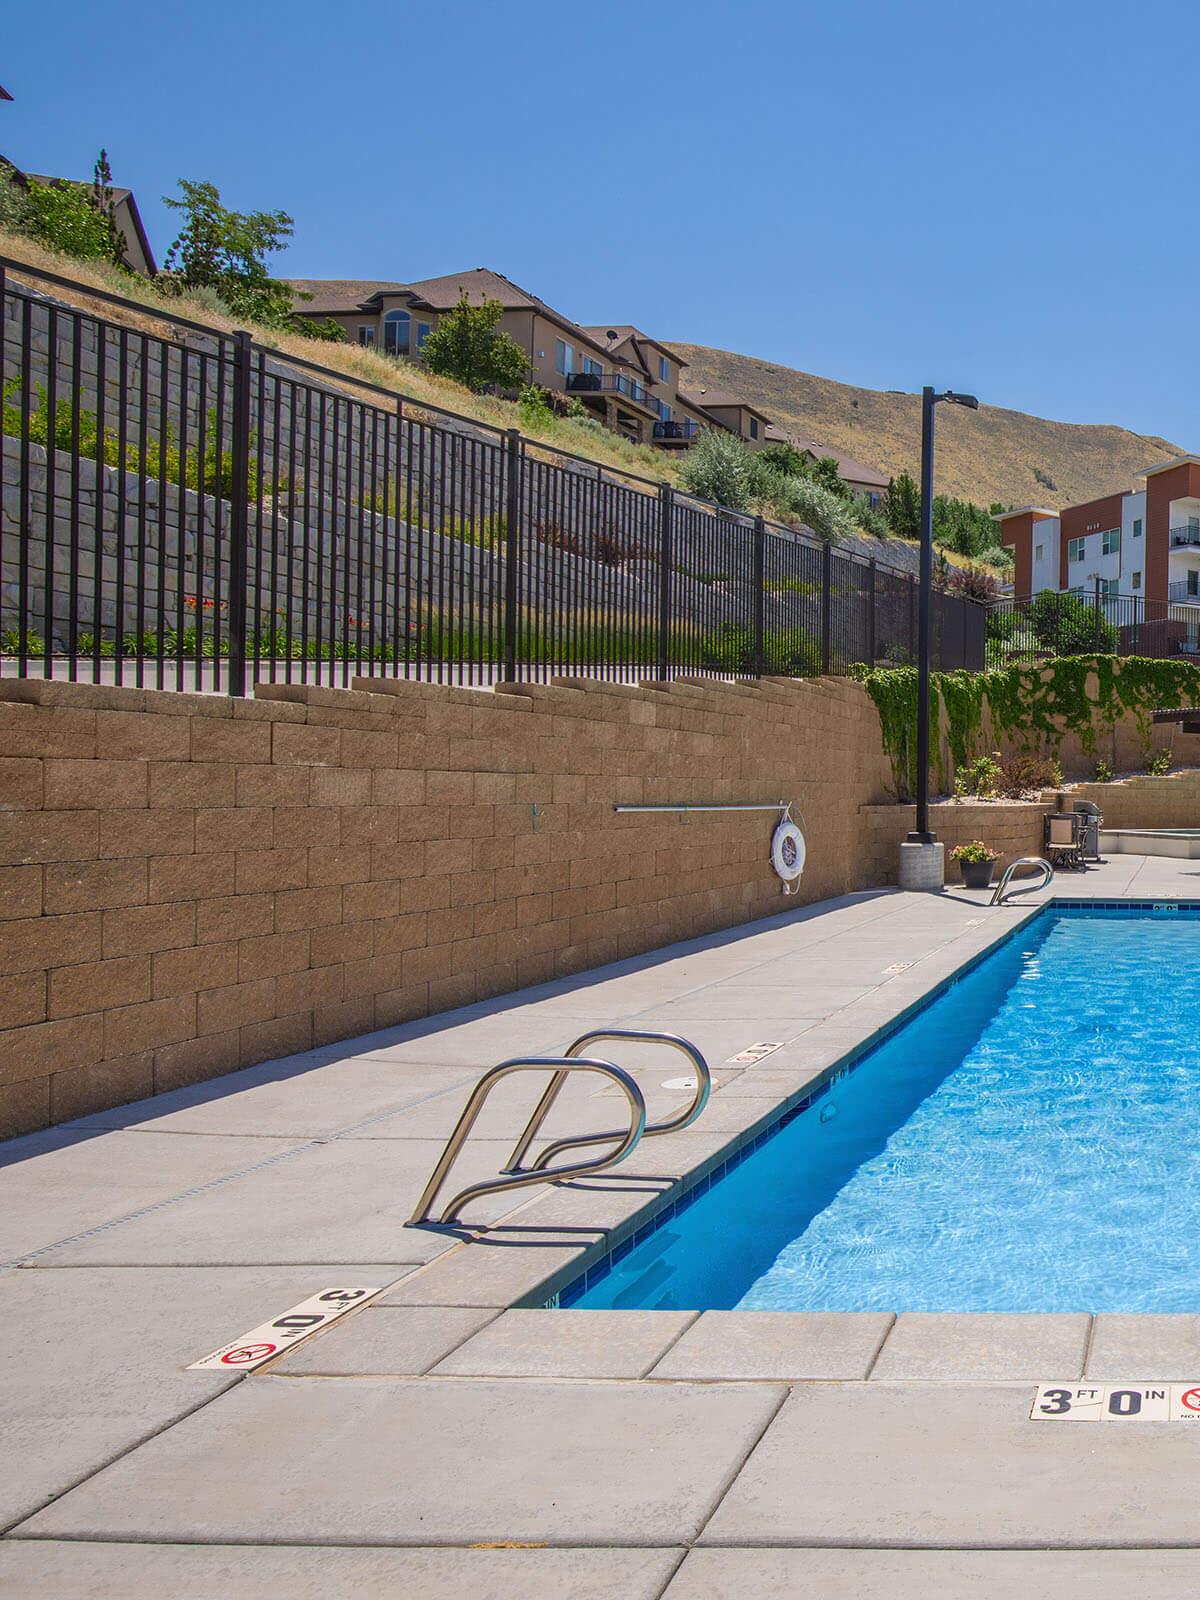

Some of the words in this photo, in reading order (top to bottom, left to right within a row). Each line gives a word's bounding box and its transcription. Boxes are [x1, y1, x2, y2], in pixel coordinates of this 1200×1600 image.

[318, 1289, 366, 1302] 3
[271, 1313, 326, 1328] 0
[1040, 1388, 1073, 1414] 3
[1076, 1389, 1099, 1399] FT
[1108, 1390, 1142, 1416] 0
[1145, 1390, 1165, 1400] IN
